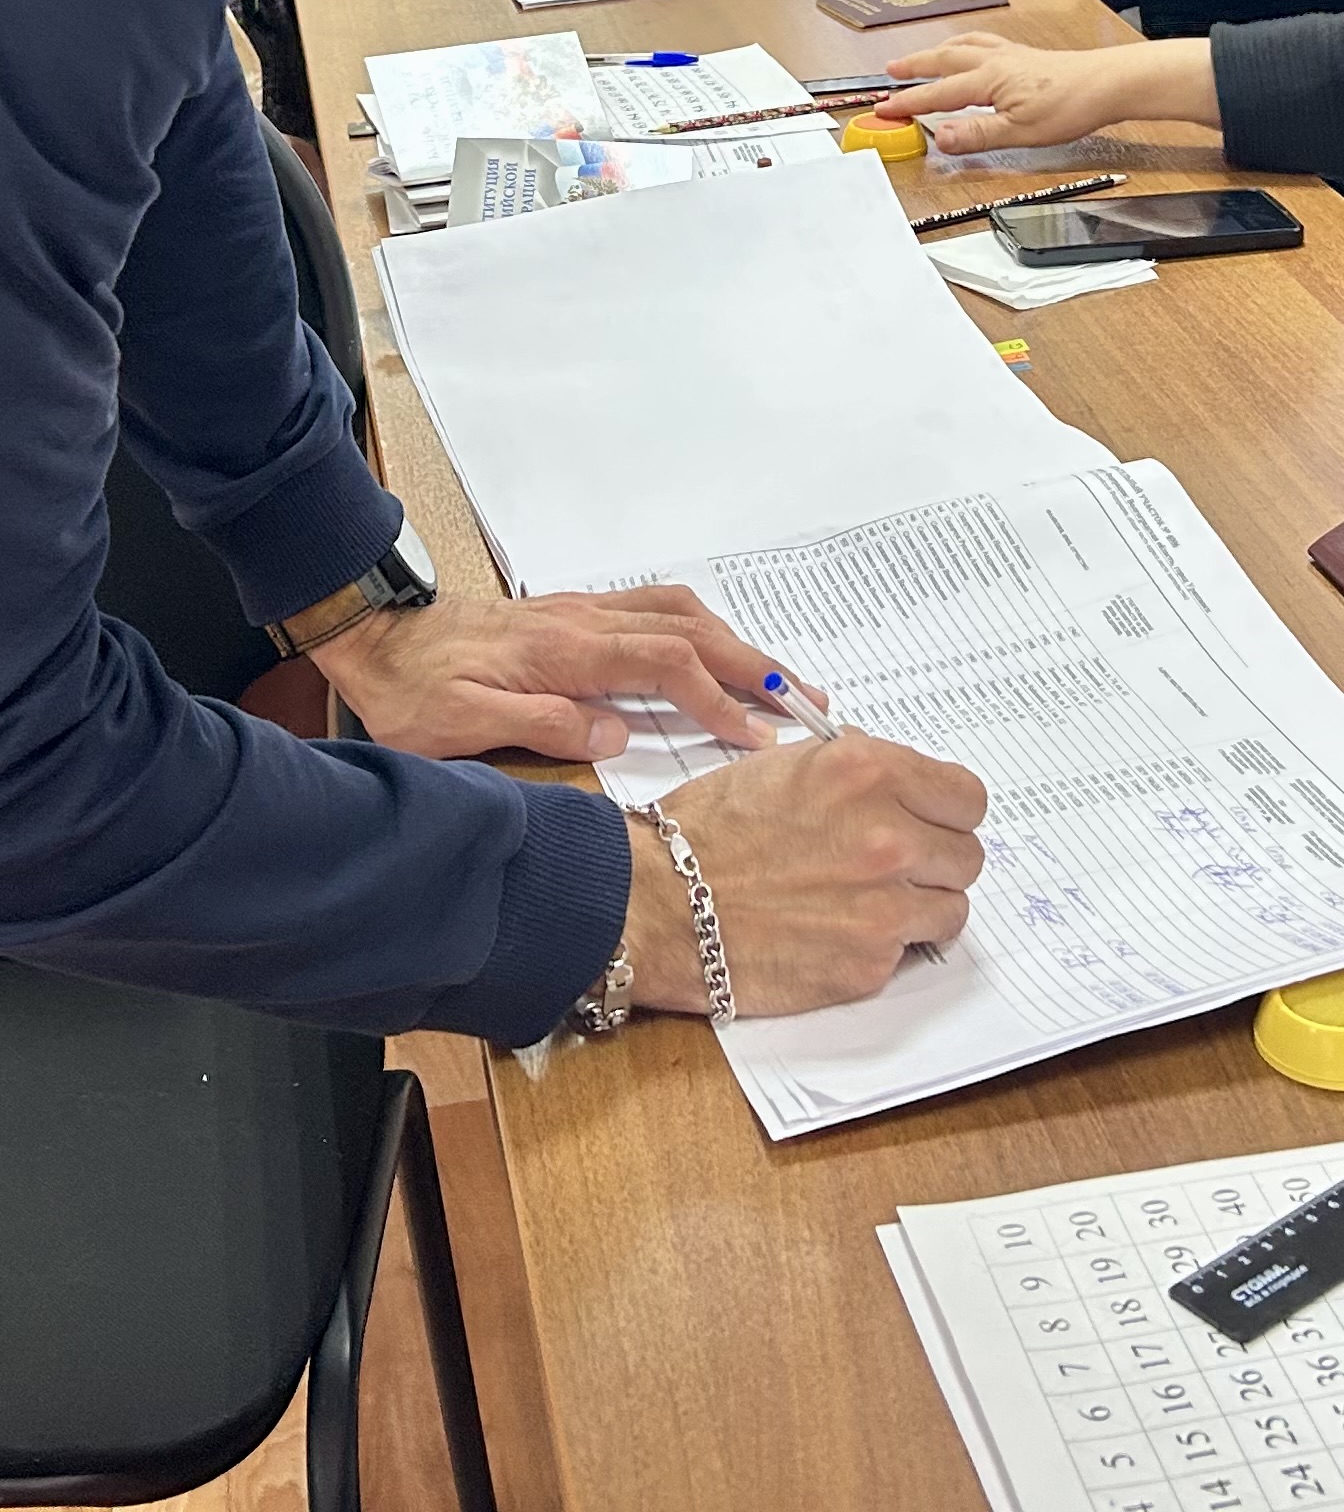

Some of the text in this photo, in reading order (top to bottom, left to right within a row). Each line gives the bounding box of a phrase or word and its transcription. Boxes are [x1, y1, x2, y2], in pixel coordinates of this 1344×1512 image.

[481, 157, 500, 222] ТИТУЦИЯ
[502, 161, 519, 220] ИЙСКОЙ
[522, 167, 538, 216] РАЦИИ
[1212, 1189, 1246, 1216] 40
[1282, 1178, 1316, 1203] 50
[1141, 1199, 1178, 1228] 30
[997, 1223, 1032, 1249] 10
[1164, 1245, 1200, 1274] 29
[1020, 1276, 1053, 1291] 9
[1039, 1318, 1071, 1332] 8
[1058, 1363, 1090, 1377] 7
[1069, 1211, 1242, 1510] 14 15 16 17 18 19 20
[1229, 1369, 1273, 1402] 26
[1077, 1406, 1111, 1422] 6
[1255, 1415, 1298, 1449] 25
[1100, 1452, 1135, 1469] 5
[1281, 1463, 1325, 1499] 24
